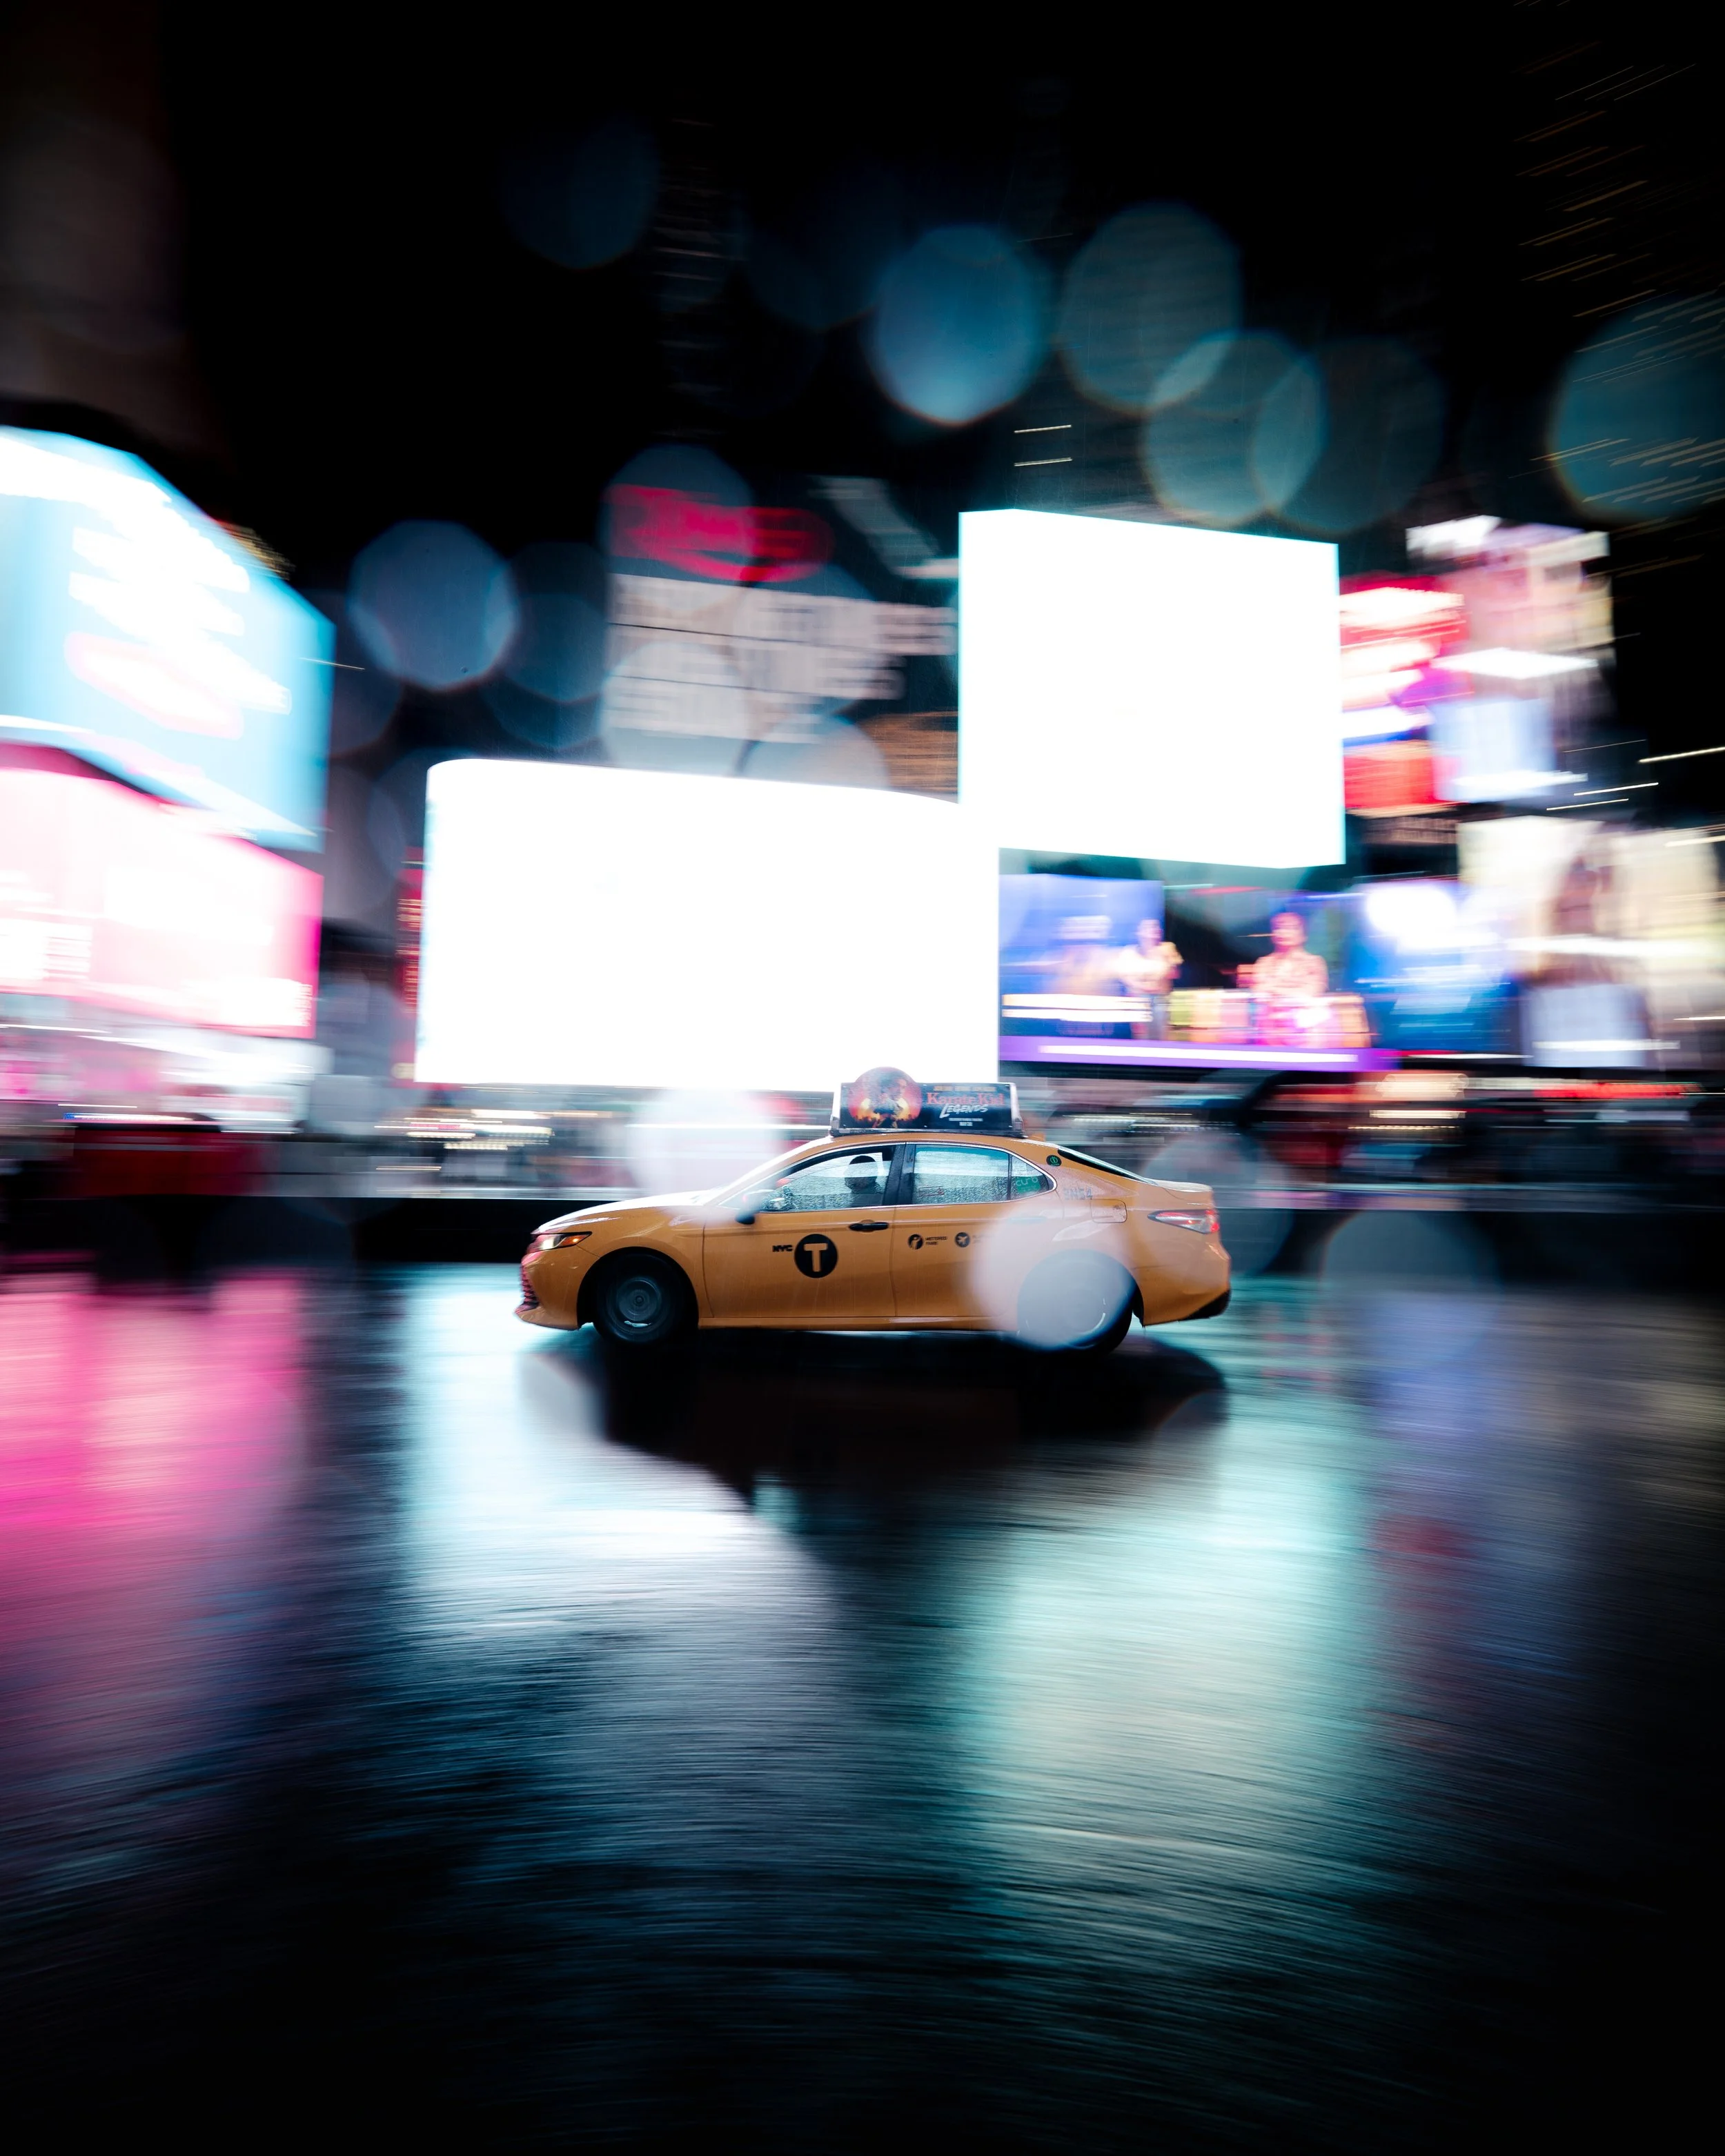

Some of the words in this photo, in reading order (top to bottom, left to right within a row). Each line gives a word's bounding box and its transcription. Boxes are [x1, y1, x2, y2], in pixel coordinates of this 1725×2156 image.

[927, 1092, 976, 1105] Karate
[977, 1093, 1005, 1105] Kid
[939, 1103, 988, 1118] LEGENDS
[803, 1243, 828, 1272] T
